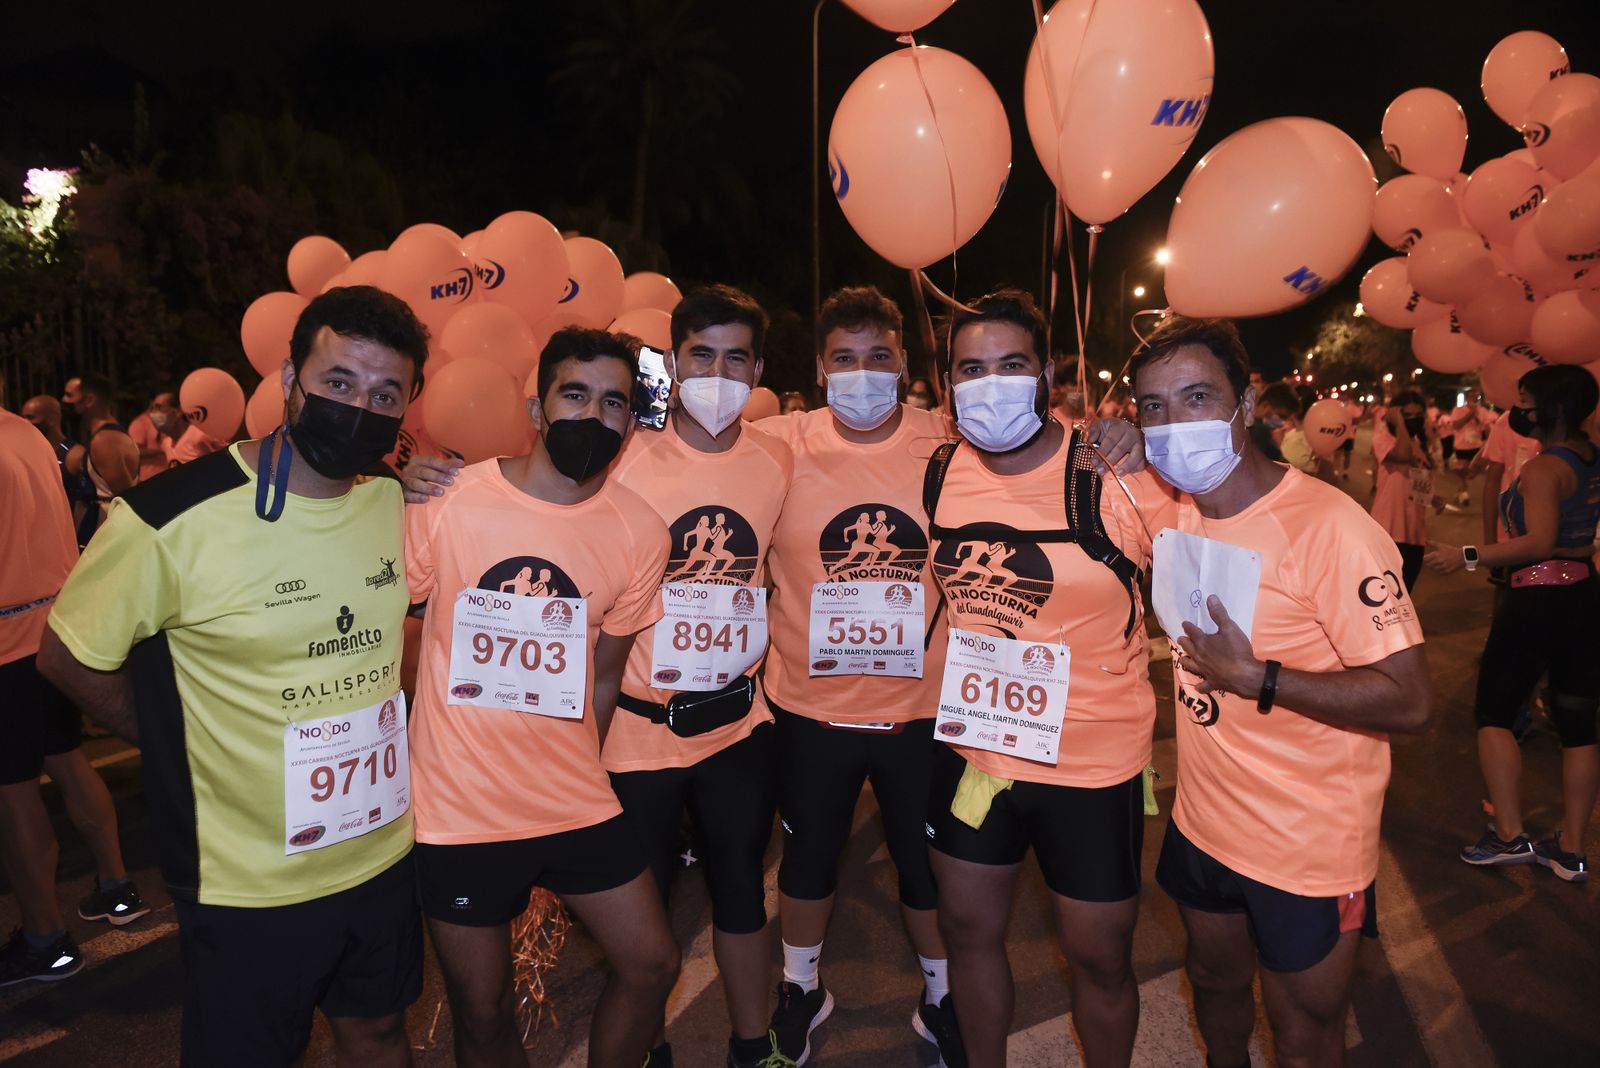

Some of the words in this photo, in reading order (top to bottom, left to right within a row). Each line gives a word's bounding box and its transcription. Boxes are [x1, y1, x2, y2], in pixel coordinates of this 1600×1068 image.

[849, 568, 920, 583] NOCTURNA
[265, 598, 292, 608] Sevilla
[294, 593, 321, 602] Wagen
[947, 590, 958, 600] LA
[959, 588, 1038, 619] NOCTURNA
[472, 623, 493, 631] CARRERA
[494, 627, 519, 635] NOCTURNA
[957, 602, 965, 614] del
[966, 603, 1024, 629] Guadalquivir
[672, 621, 749, 653] 8941
[827, 617, 904, 646] 5551
[472, 632, 567, 675] 9703
[845, 648, 871, 656] MARTIN
[282, 661, 395, 701] GALISPORT
[455, 687, 478, 696] KH7
[961, 672, 1048, 717] 6169
[940, 704, 966, 716] MIGUEL
[968, 710, 991, 721] ANGEL
[992, 714, 1018, 726] MARTIN
[1019, 719, 1060, 734] DOMINGUEZ
[309, 755, 333, 764] CARRERA
[335, 748, 360, 759] NOCTURNA
[310, 743, 397, 802] 9710
